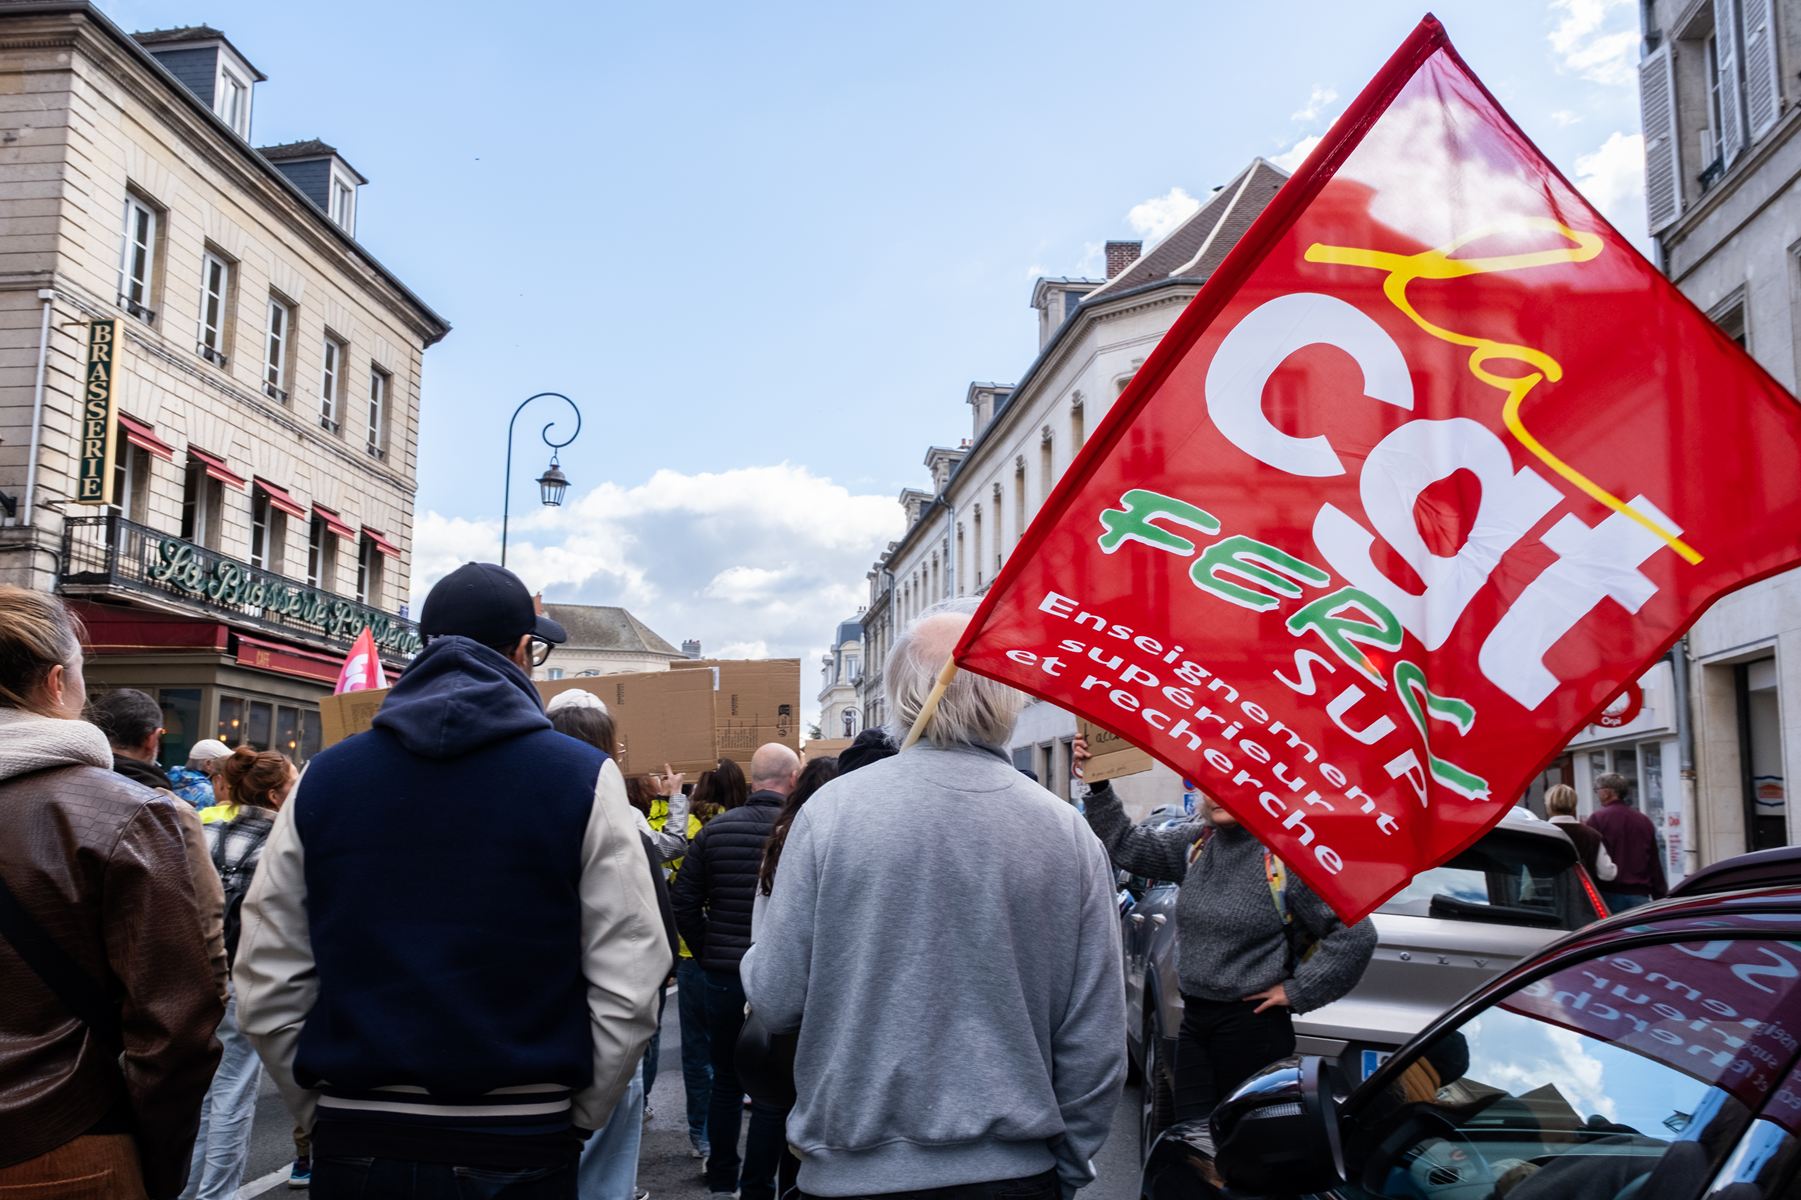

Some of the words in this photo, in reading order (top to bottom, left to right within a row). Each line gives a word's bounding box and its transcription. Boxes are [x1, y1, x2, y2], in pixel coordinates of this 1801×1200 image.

[80, 325, 112, 497] BRASSERIE
[153, 539, 206, 593] La
[208, 560, 331, 625] Brasserie
[1005, 649, 1068, 677] et
[1080, 675, 1344, 876] recherche
[1037, 591, 1400, 836] Enseignement
[1058, 638, 1335, 813] supérieur
[1272, 648, 1429, 809] SUP
[1399, 951, 1489, 968] OLV
